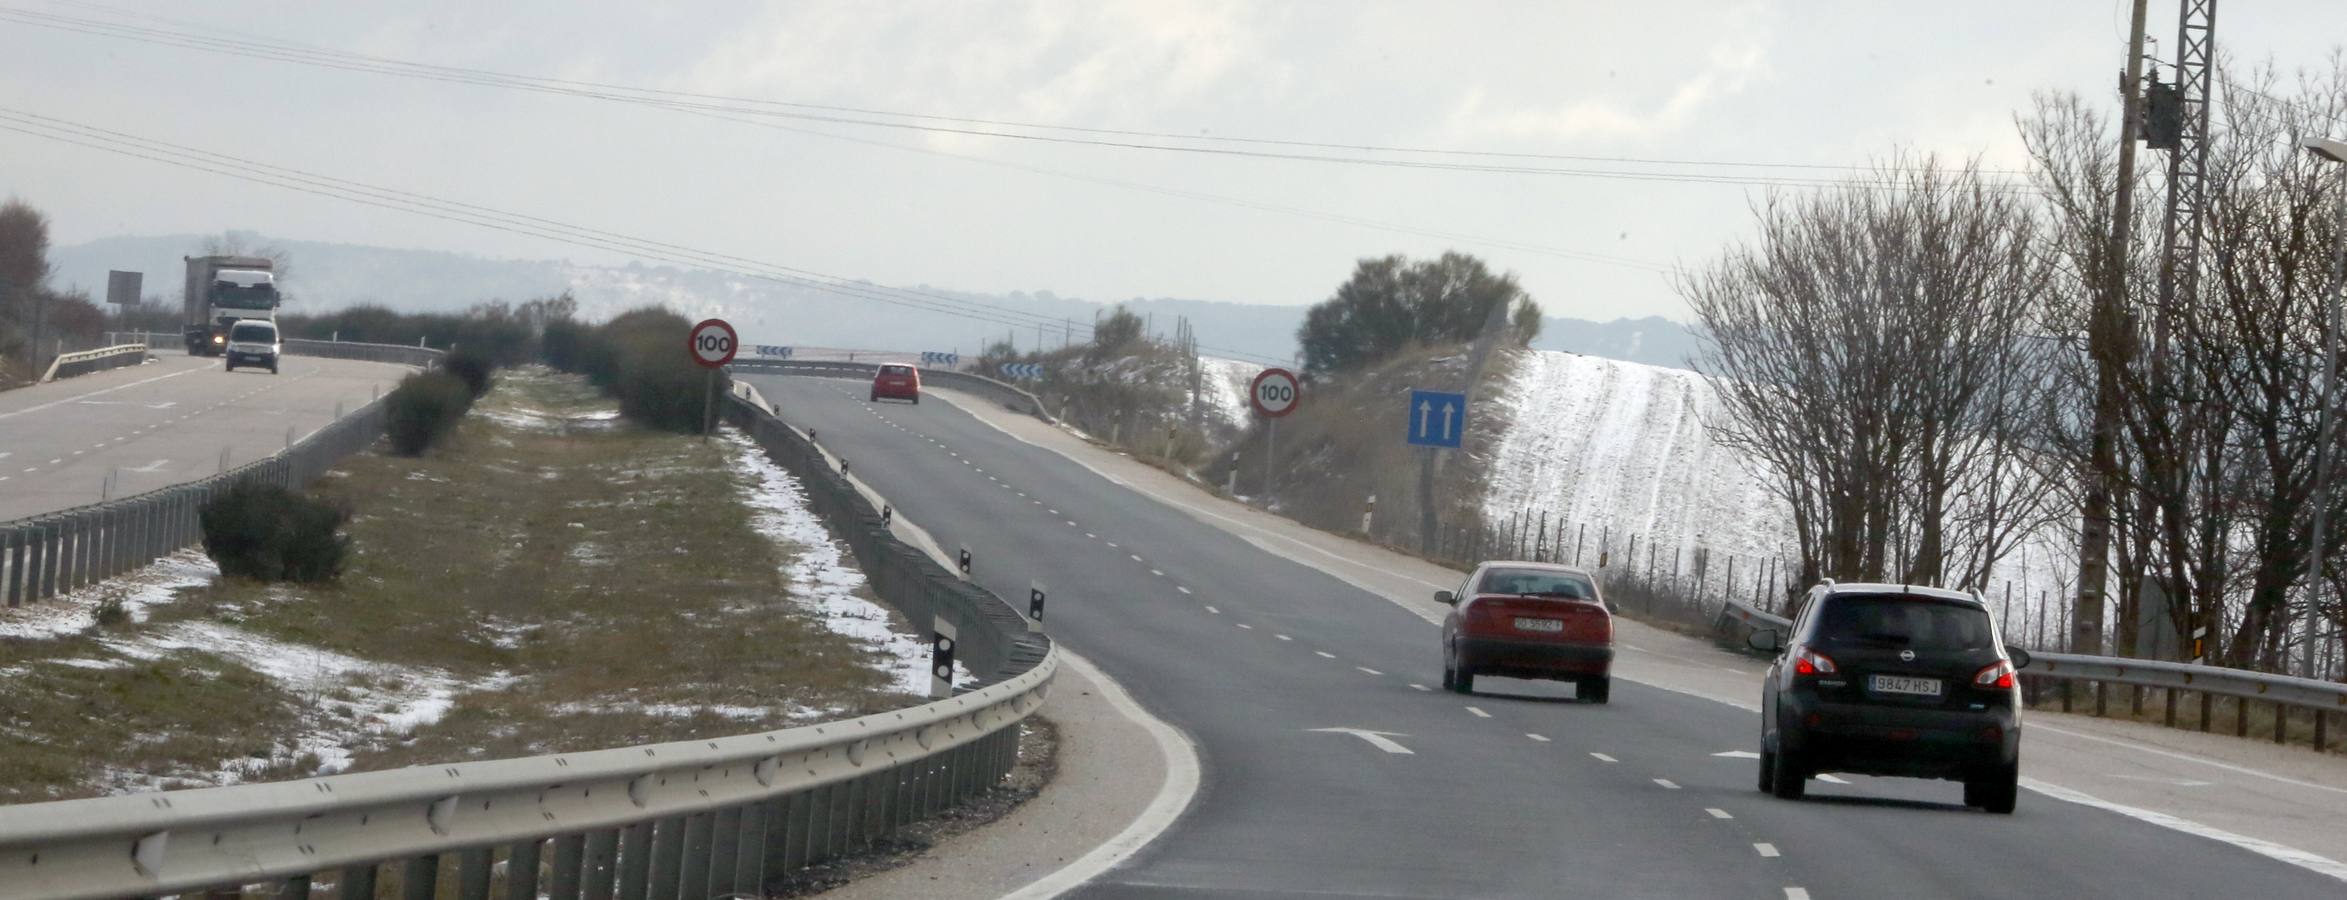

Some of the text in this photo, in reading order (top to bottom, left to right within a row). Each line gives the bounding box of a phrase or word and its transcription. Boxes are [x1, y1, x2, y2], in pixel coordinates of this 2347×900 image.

[697, 335, 730, 353] 100
[1262, 384, 1292, 402] 100
[1878, 677, 1938, 693] 9847 HSJ
